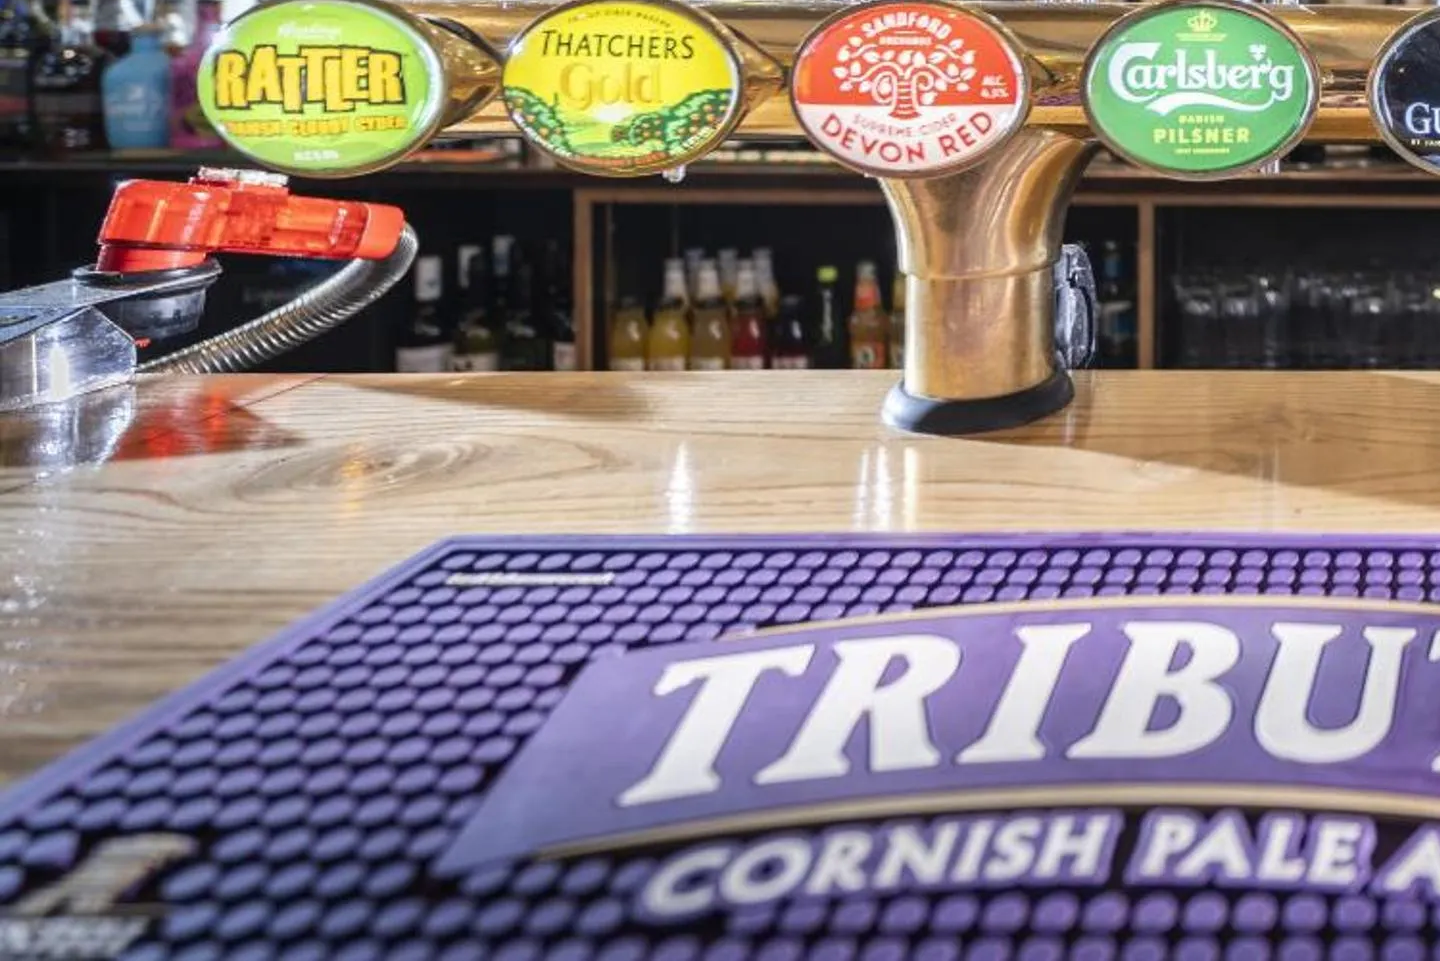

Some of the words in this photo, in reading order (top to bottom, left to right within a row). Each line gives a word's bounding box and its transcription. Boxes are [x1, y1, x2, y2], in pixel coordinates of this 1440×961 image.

[540, 28, 695, 60] THATCHERS
[860, 11, 953, 39] SANDFORD
[215, 43, 407, 114] RATTLER
[559, 62, 663, 111] Gold
[1108, 42, 1295, 105] Carlsberg
[821, 112, 926, 163] DEVON
[938, 111, 993, 157] RED
[1152, 127, 1252, 145] PILSNER
[644, 814, 1111, 915] CORNISH
[1139, 814, 1363, 884] PALE
